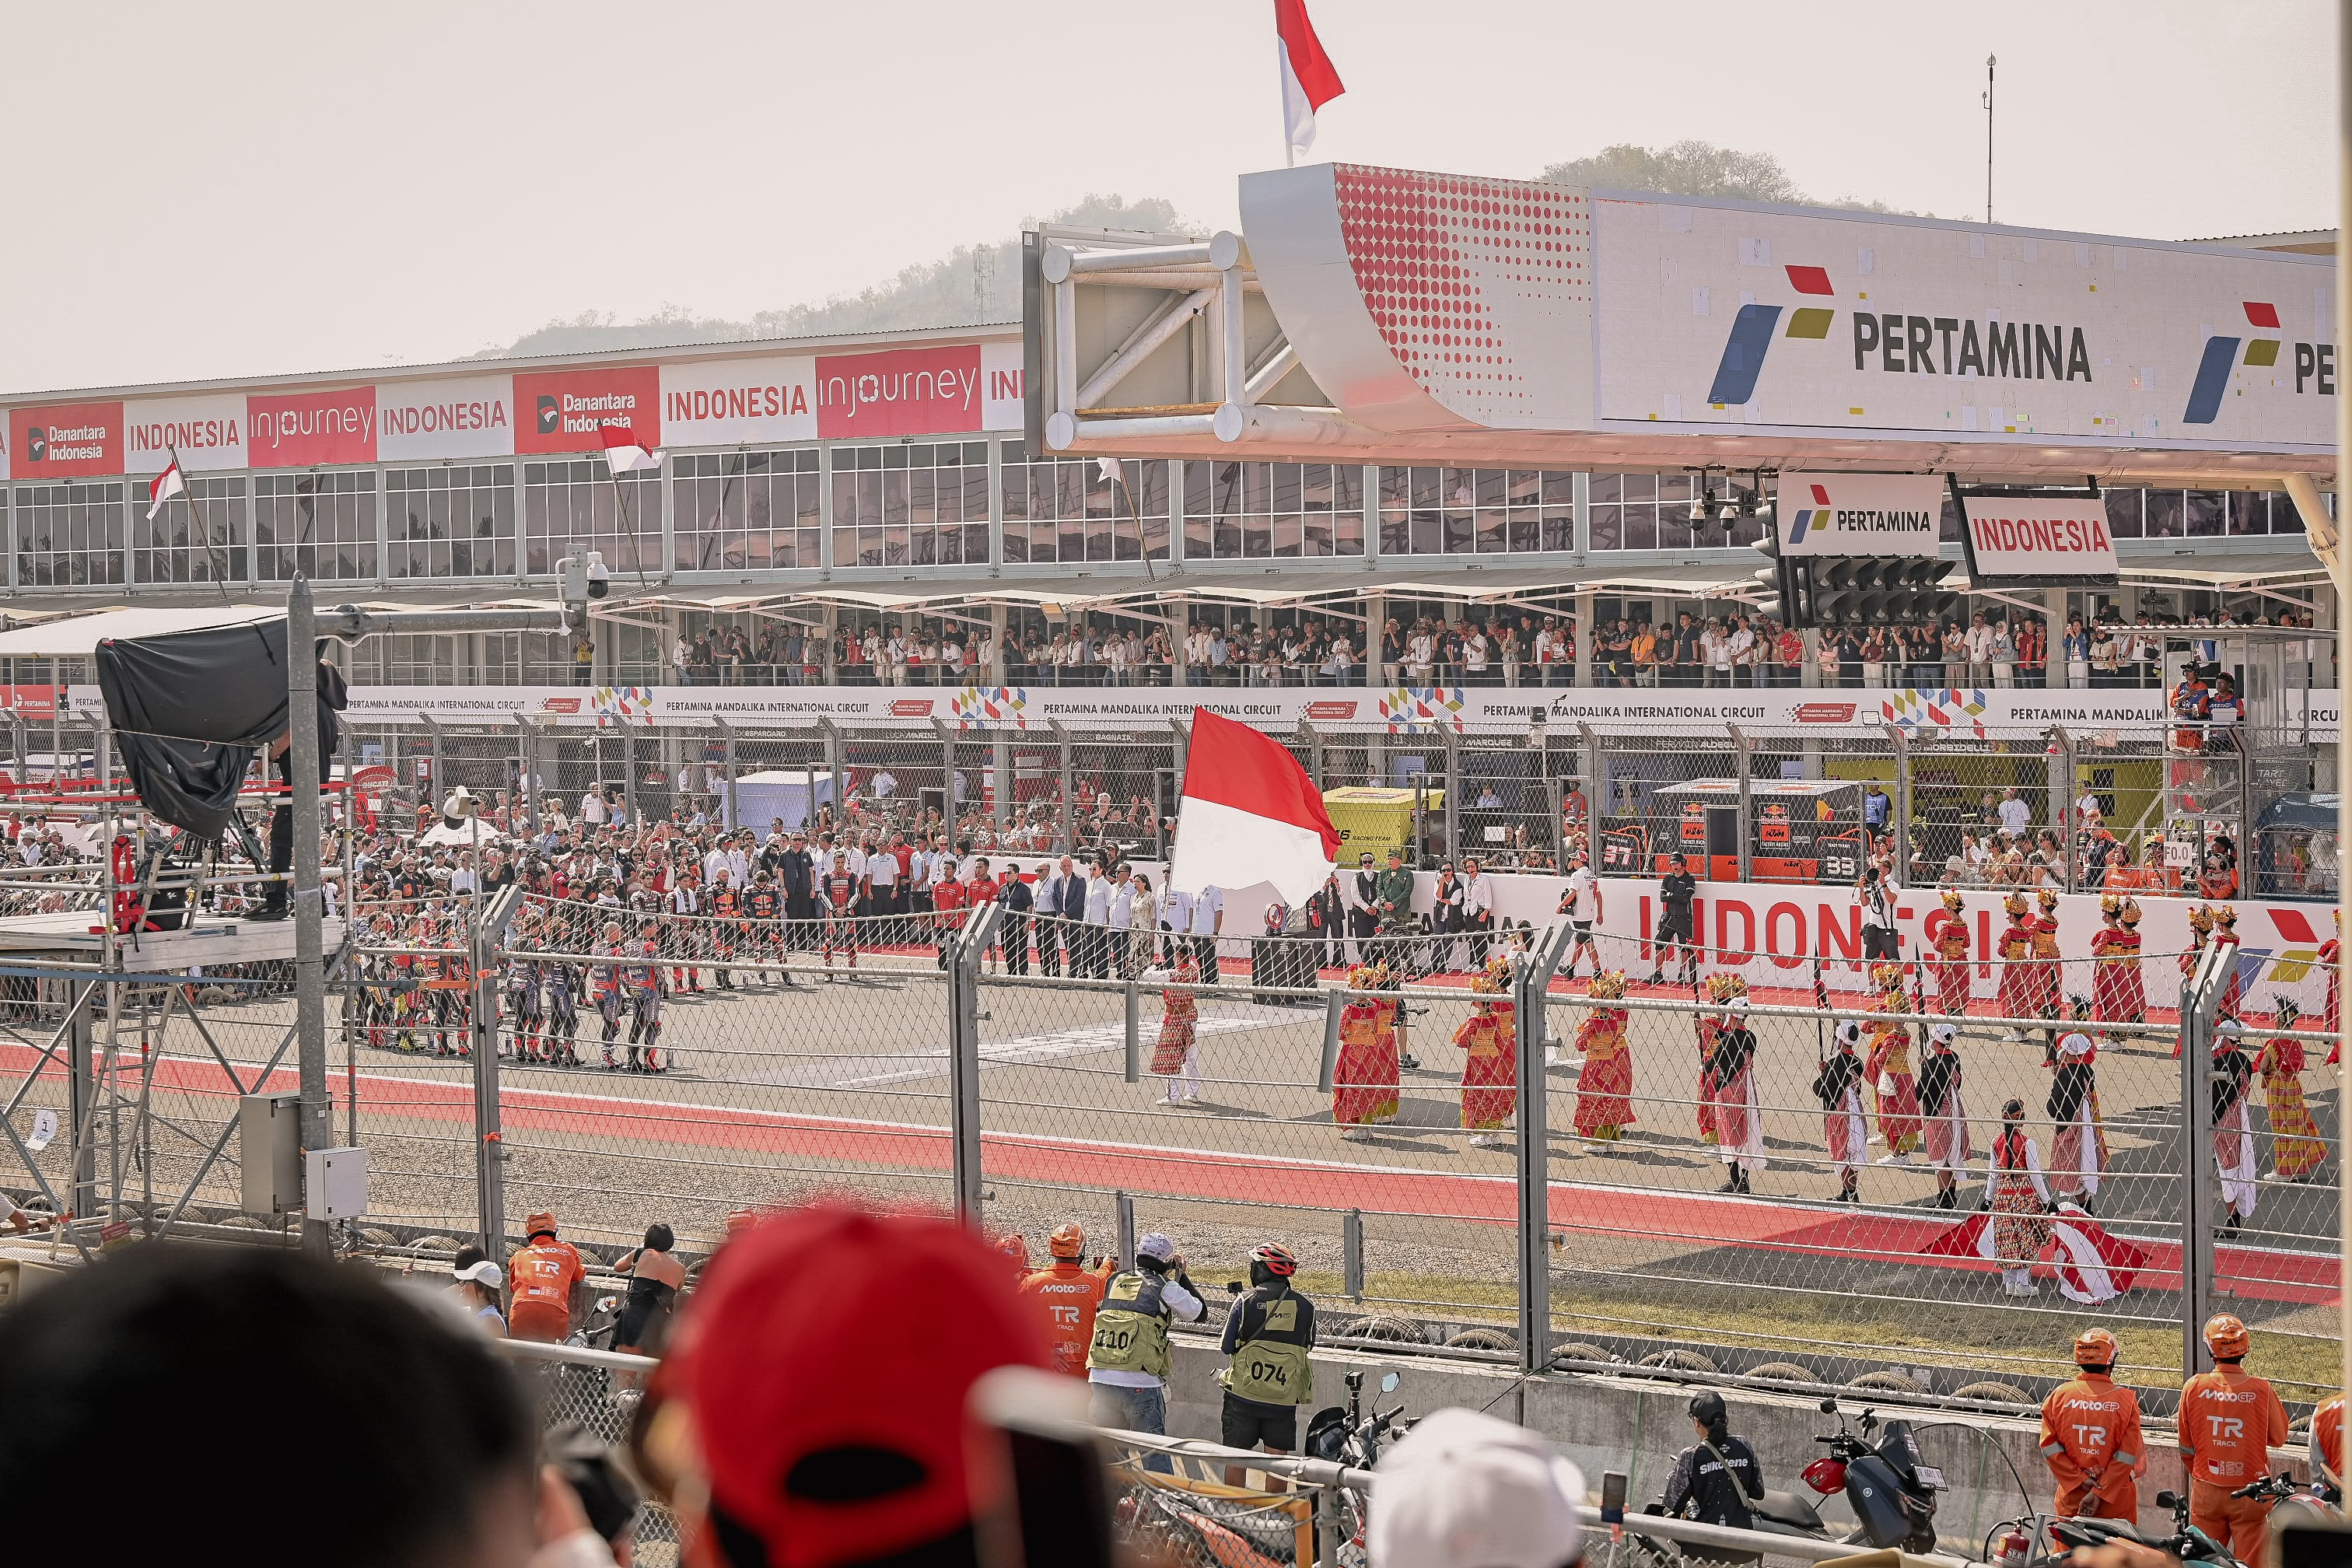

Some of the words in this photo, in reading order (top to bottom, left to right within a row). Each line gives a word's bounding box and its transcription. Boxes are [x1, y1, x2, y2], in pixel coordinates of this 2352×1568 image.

[1853, 311, 2093, 383] PERTAMINA
[2294, 342, 2339, 396] PE
[563, 392, 635, 412] Danantara
[819, 366, 977, 418] injourney
[667, 384, 808, 422] INDONESIA
[250, 404, 374, 449] injourney
[383, 401, 507, 436] INDONESIA
[563, 412, 632, 433] Indonesia
[49, 425, 106, 443] Danantara
[130, 419, 240, 452] INDONESIA
[49, 443, 103, 461] Indonesia
[1836, 509, 1931, 533] PERTAMINA
[1972, 517, 2110, 552] INDONESIA
[75, 698, 103, 707] PERTAMI
[349, 700, 389, 709] PERTAMINA
[391, 700, 435, 709] MANDALIKA
[437, 700, 495, 710] INTERNATIONAL
[497, 701, 525, 710] CIRCUIT
[667, 702, 712, 712] PERTAMINA
[715, 702, 765, 712] MANDALIKA
[768, 702, 835, 712] INTERNATIONAL
[837, 703, 870, 713] CIRCUIT
[1044, 704, 1097, 714] PERTAMINA
[1101, 705, 1160, 714] MANDALIKA
[1243, 705, 1282, 715] CIRCUIT
[1484, 705, 1533, 716] PERTAMI
[1551, 706, 1620, 717] MANDALIKA
[1624, 707, 1717, 718] INTERNATIONAL
[1720, 707, 1766, 718] CIRCUIT
[2011, 709, 2088, 720] PERTAMINA
[2091, 709, 2162, 721] MANDALIK
[1699, 740, 1739, 749] ALDEGU
[1827, 856, 1856, 876] 33
[531, 1260, 560, 1275] TR
[1038, 1284, 1090, 1293] MotoGP
[1049, 1305, 1080, 1324] TR
[1096, 1329, 1129, 1350] 110
[1251, 1361, 1287, 1386] 074
[2064, 1398, 2120, 1412] MotoGP
[2198, 1388, 2256, 1403] MotoGP
[2072, 1424, 2106, 1446] TR
[2207, 1416, 2243, 1438] TR
[1699, 1458, 1748, 1475] Silkoene
